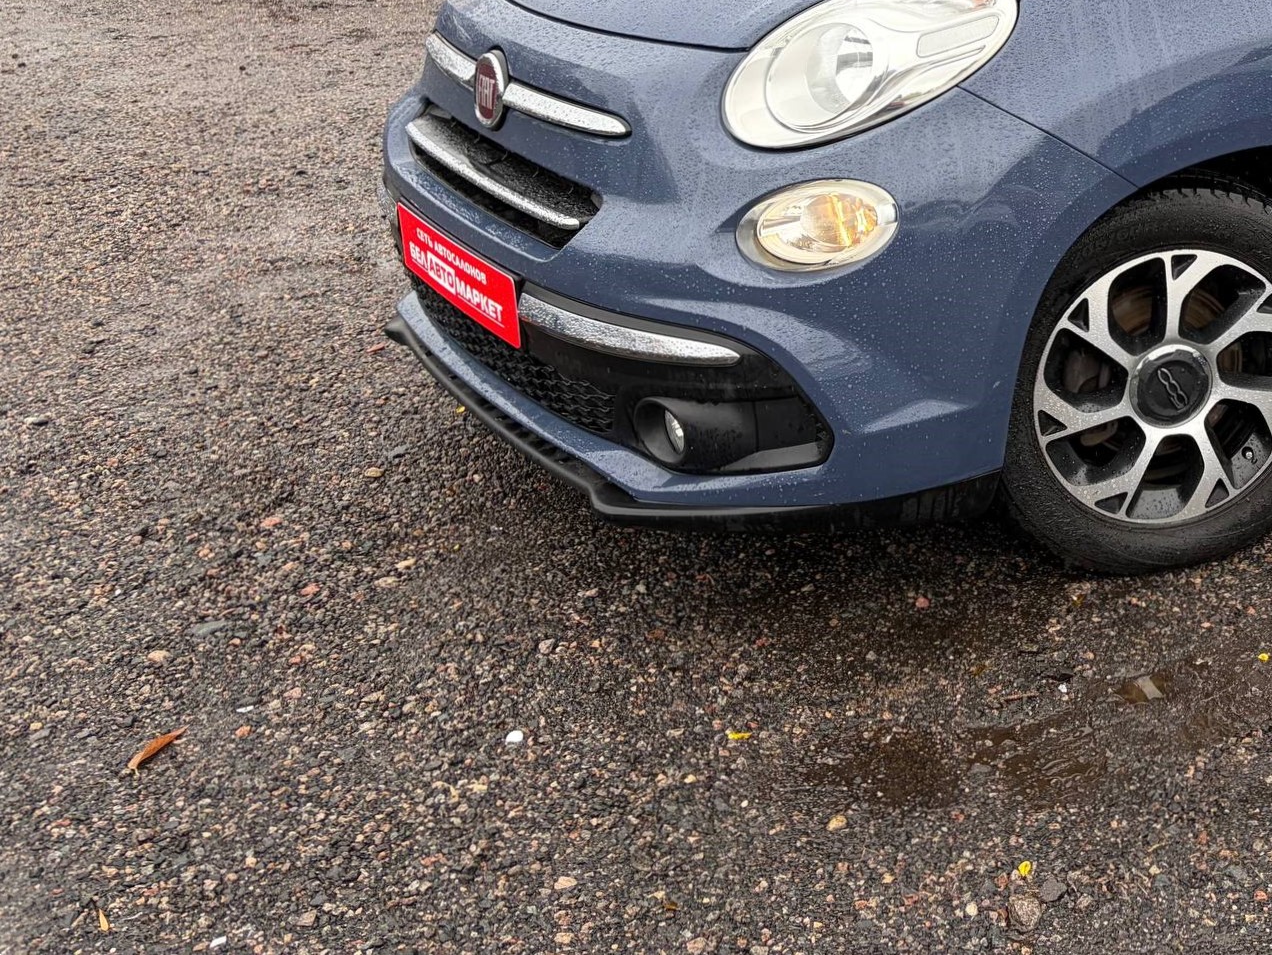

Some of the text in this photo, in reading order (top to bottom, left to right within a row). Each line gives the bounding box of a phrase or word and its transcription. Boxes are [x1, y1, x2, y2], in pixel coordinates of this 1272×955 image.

[409, 241, 503, 322] БЕЛ АВТО МАРКЕТ
[416, 227, 487, 285] СЕТЬ АВТОСАЛОНОВ
